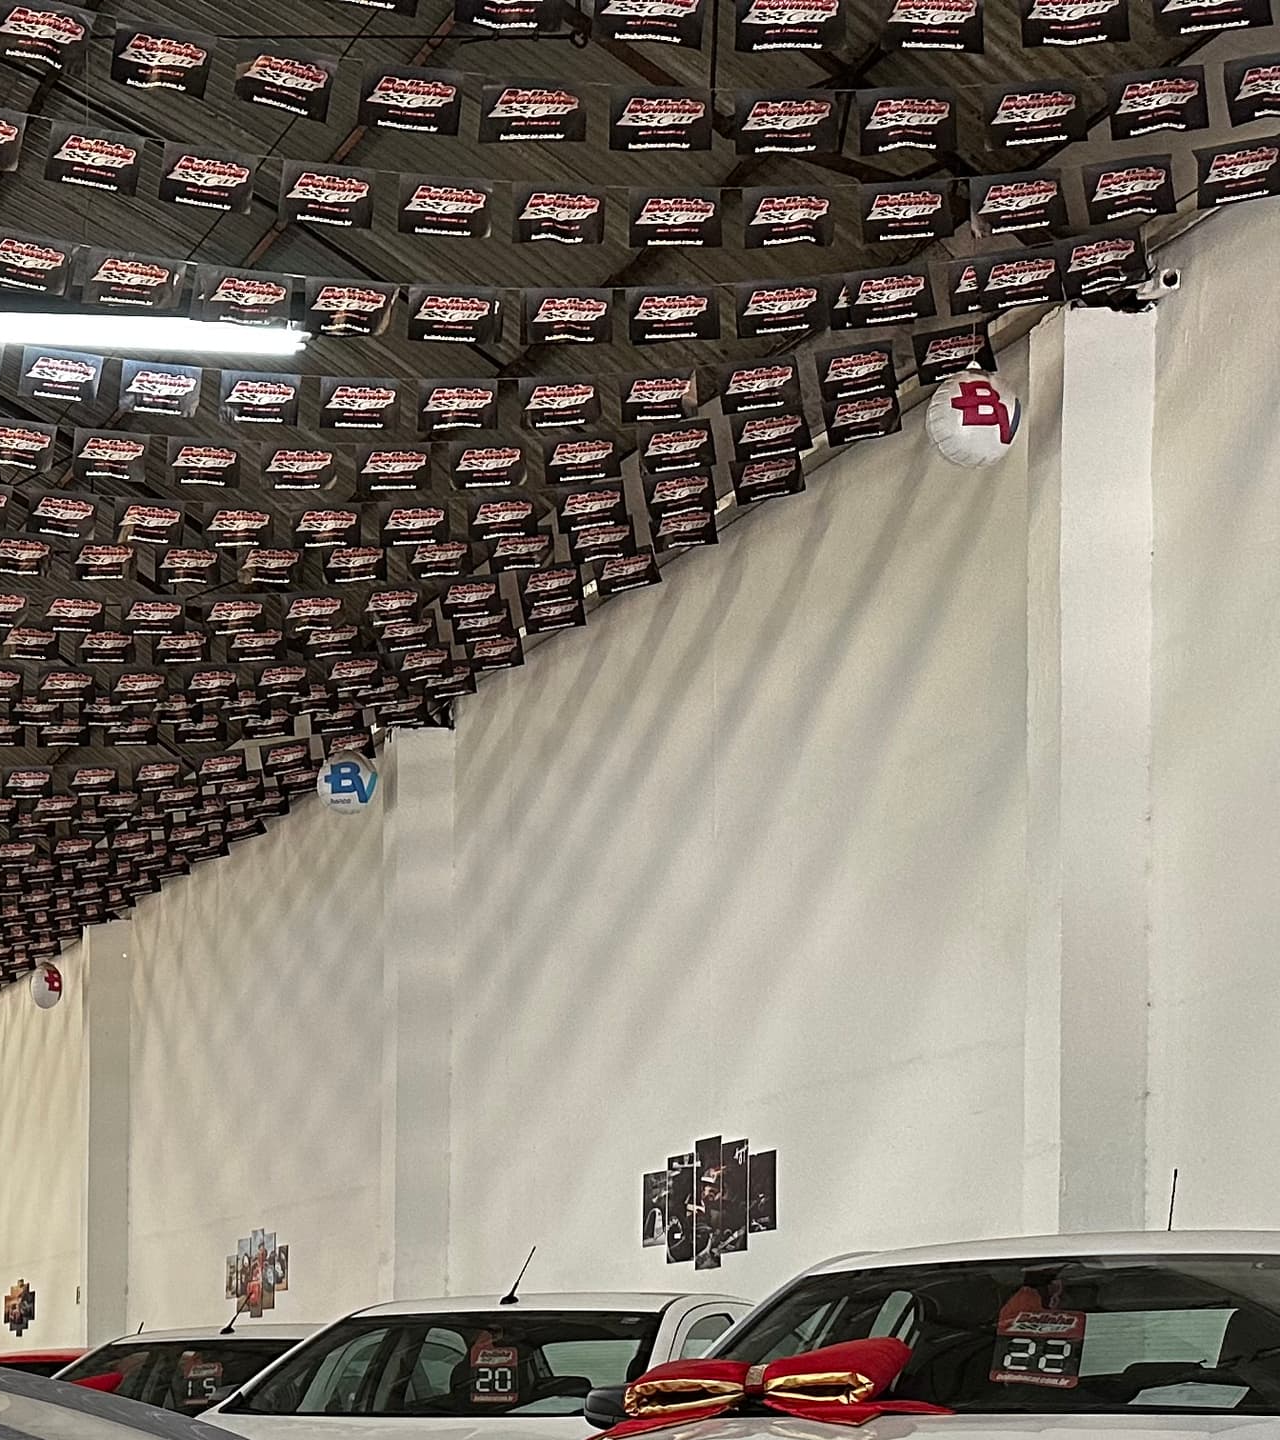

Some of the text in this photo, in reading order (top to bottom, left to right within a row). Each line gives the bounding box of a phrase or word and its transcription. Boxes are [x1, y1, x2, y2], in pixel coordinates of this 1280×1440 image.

[324, 762, 378, 803] BV
[1003, 1338, 1071, 1373] 22
[187, 1377, 217, 1397] 15
[475, 1367, 512, 1392] 20
